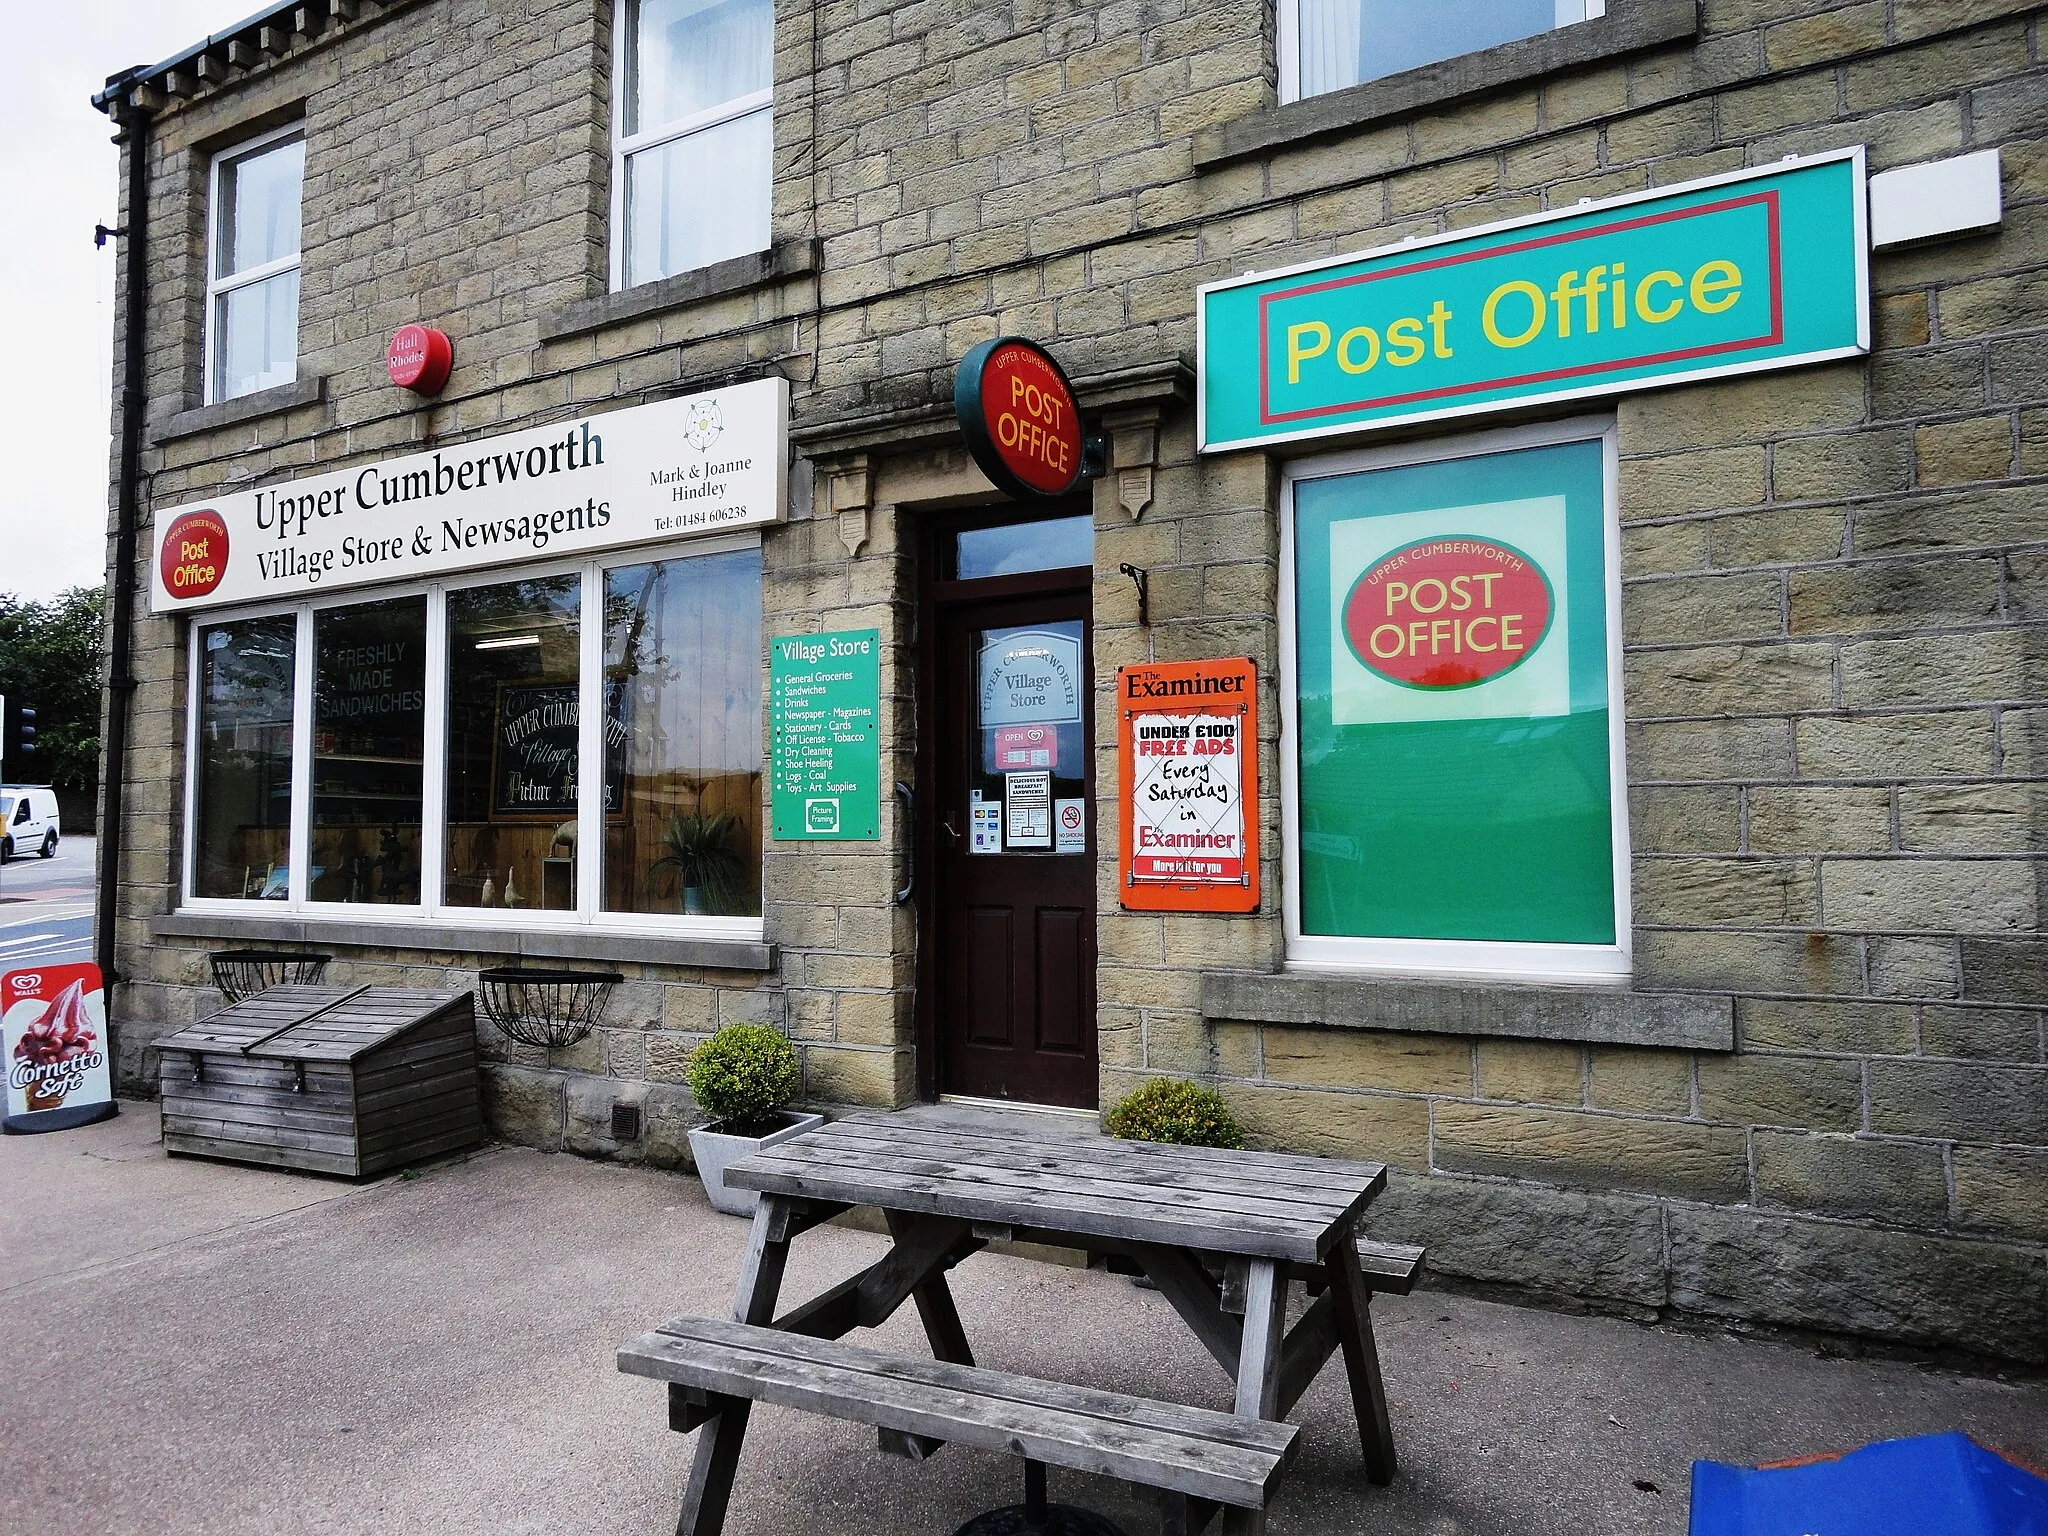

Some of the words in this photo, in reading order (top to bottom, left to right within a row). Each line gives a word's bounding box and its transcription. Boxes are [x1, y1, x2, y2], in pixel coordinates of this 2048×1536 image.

[1287, 300, 1454, 385] Post
[1481, 259, 1743, 348] Office
[396, 333, 418, 351] Hall
[390, 351, 425, 368] Rhodes
[995, 351, 1019, 369] UPPER
[1011, 375, 1063, 430] POST
[998, 412, 1069, 474] OFFICE
[255, 486, 346, 539] Upper
[355, 421, 605, 510] Cumberworth
[650, 467, 685, 486] Mark
[689, 465, 700, 479] &
[704, 458, 752, 481] Joanne
[672, 481, 727, 502] Hindley
[654, 516, 673, 530] Tel:
[676, 512, 706, 528] 01484
[709, 505, 747, 522] 606238
[165, 527, 182, 547] UPPER
[256, 548, 334, 582] Village
[342, 536, 403, 567] Store
[411, 525, 433, 556] &
[441, 497, 611, 551] Newsagents
[181, 537, 209, 561] Post
[1368, 555, 1408, 586] UPPER
[1411, 542, 1524, 572] CUMBERWORTH
[173, 563, 216, 587] Office
[1386, 572, 1503, 617] POST
[1370, 614, 1524, 659] OFFICE
[338, 642, 405, 668] FRESHLY
[782, 641, 825, 664] Village
[829, 637, 870, 657] Store
[349, 668, 393, 691] MADE
[784, 673, 813, 684] General
[815, 671, 853, 682] Groceries
[1005, 674, 1052, 691] Village
[1126, 672, 1246, 698] Examiner
[1143, 671, 1160, 681] The
[784, 685, 826, 696] Sandwiches
[983, 667, 1003, 712] UPPER
[321, 690, 422, 718] SANDWICHES
[784, 698, 809, 708] Drinks
[1010, 693, 1046, 708] Store
[784, 710, 826, 721] Newspaper
[833, 707, 871, 719] Magazines
[505, 708, 540, 747] UPPER
[784, 722, 822, 734] Stationery
[829, 720, 851, 731] Cards
[1140, 725, 1190, 739] UNDER
[1195, 724, 1235, 738] £100
[785, 735, 797, 745] Off
[799, 734, 826, 744] License
[833, 732, 865, 742] Tobacco
[1005, 733, 1024, 742] OPEN
[1193, 738, 1235, 756] ADS
[520, 738, 571, 778] Village
[785, 747, 799, 759] Dry
[801, 746, 833, 757] Cleaning
[785, 759, 803, 768] Shoe
[805, 758, 833, 769] Heeling
[1163, 760, 1210, 783] Every
[785, 771, 802, 783] Logs
[809, 770, 827, 780] Coal
[786, 783, 802, 795] Toys
[809, 783, 822, 792] Art
[826, 781, 857, 794] Supplies
[1148, 783, 1228, 803] Saturday
[811, 815, 834, 824] Framing
[813, 806, 832, 814] Picture
[1180, 805, 1197, 820] in
[1140, 825, 1235, 848] Examiner
[1153, 860, 1174, 872] More
[1176, 860, 1183, 872] in
[1185, 860, 1193, 872] it
[1193, 861, 1206, 873] for
[1207, 862, 1222, 874] you
[13, 988, 41, 996] WALL'S
[10, 1052, 103, 1090] Cornetto
[35, 1072, 84, 1099] Soft
